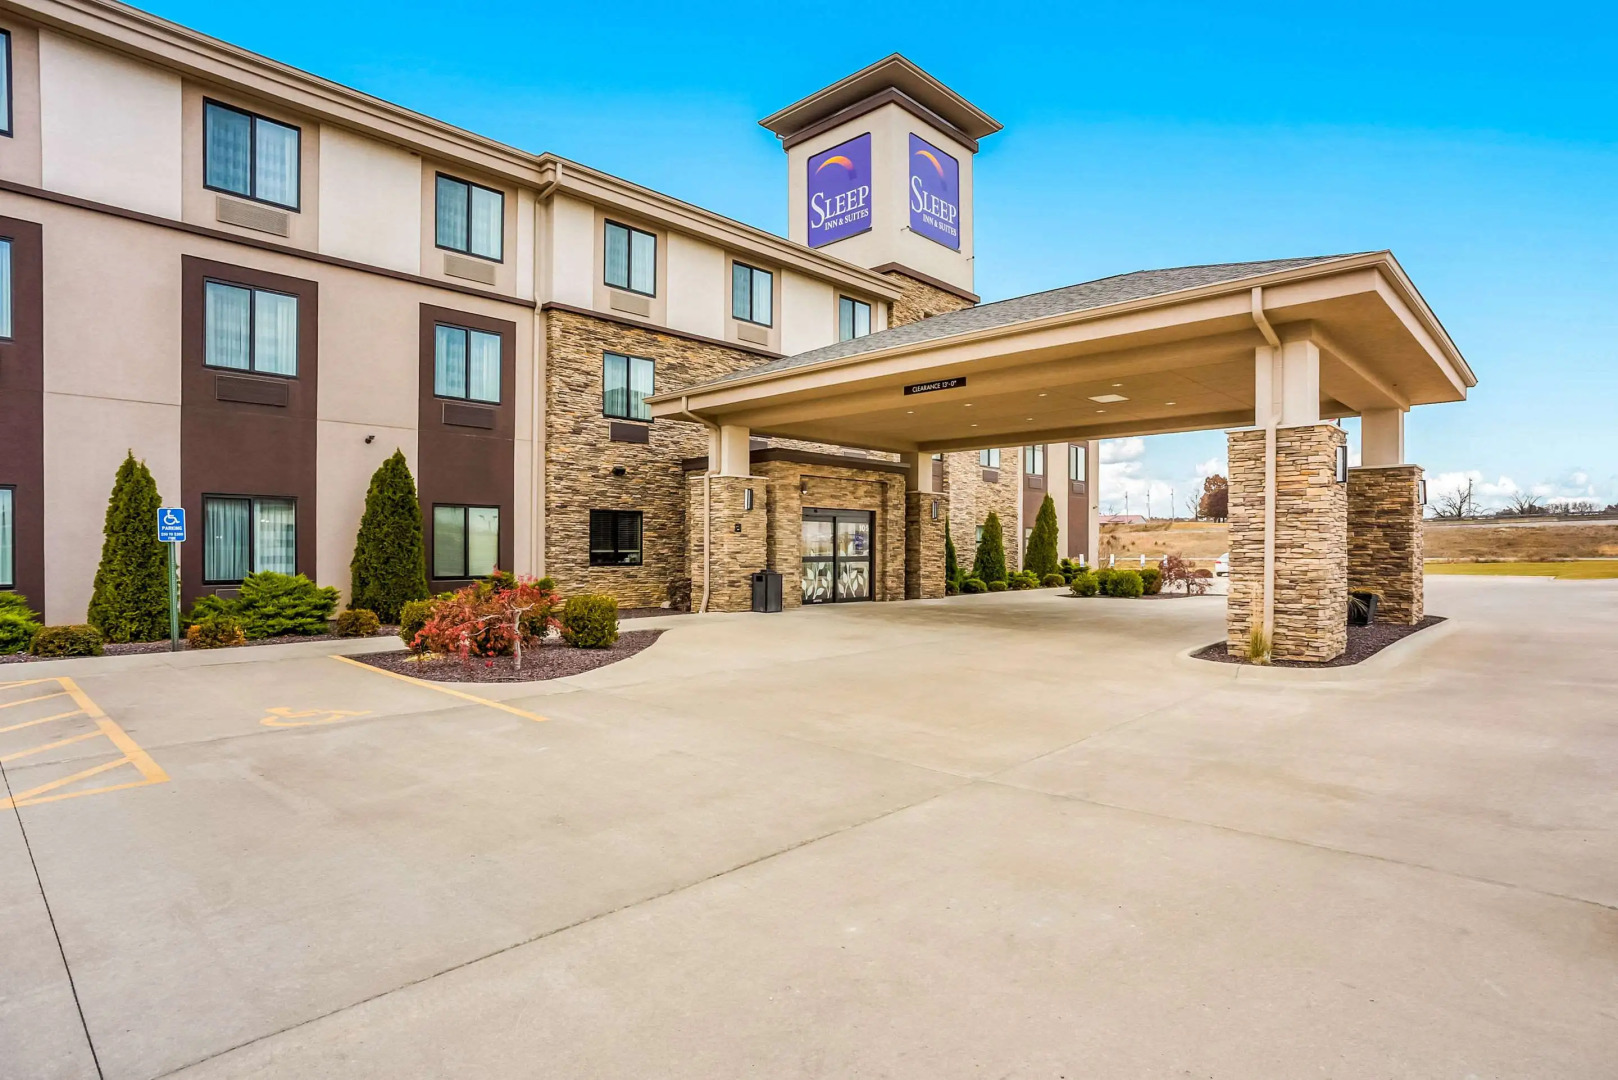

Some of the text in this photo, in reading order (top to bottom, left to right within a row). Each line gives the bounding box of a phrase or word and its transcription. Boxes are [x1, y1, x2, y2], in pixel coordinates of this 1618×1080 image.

[811, 185, 869, 229] SLEEP
[911, 175, 957, 224] SLEEP
[824, 207, 869, 231] INN & SUITES
[922, 213, 934, 226] INN
[938, 221, 957, 237] SUITES
[912, 383, 940, 393] CLEARANCE
